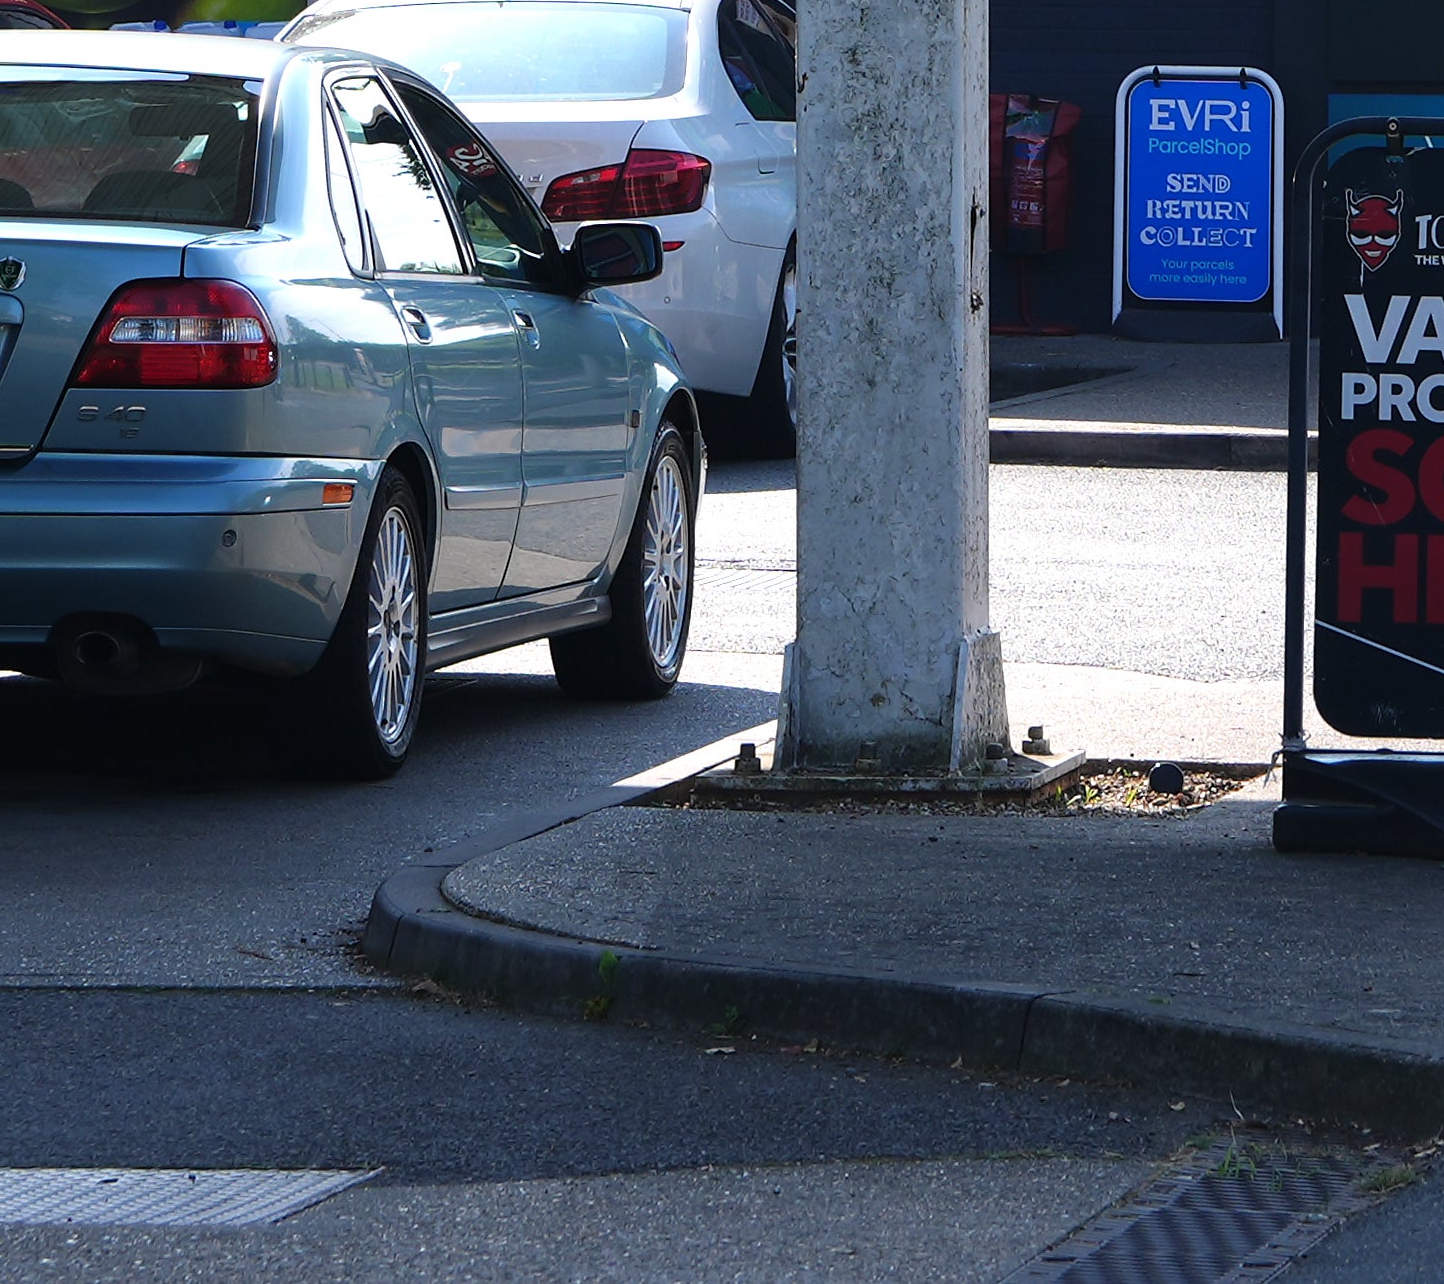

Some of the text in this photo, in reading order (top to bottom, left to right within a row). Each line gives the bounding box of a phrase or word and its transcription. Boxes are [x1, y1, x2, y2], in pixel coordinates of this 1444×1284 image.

[1148, 137, 1251, 160] ParcelShop
[1166, 173, 1231, 194] SEND
[1146, 199, 1250, 221] RETURN
[1140, 226, 1257, 247] COLLECT
[1161, 258, 1234, 271] Your parcels
[1415, 255, 1439, 267] THE
[1149, 273, 1247, 286] more easily here
